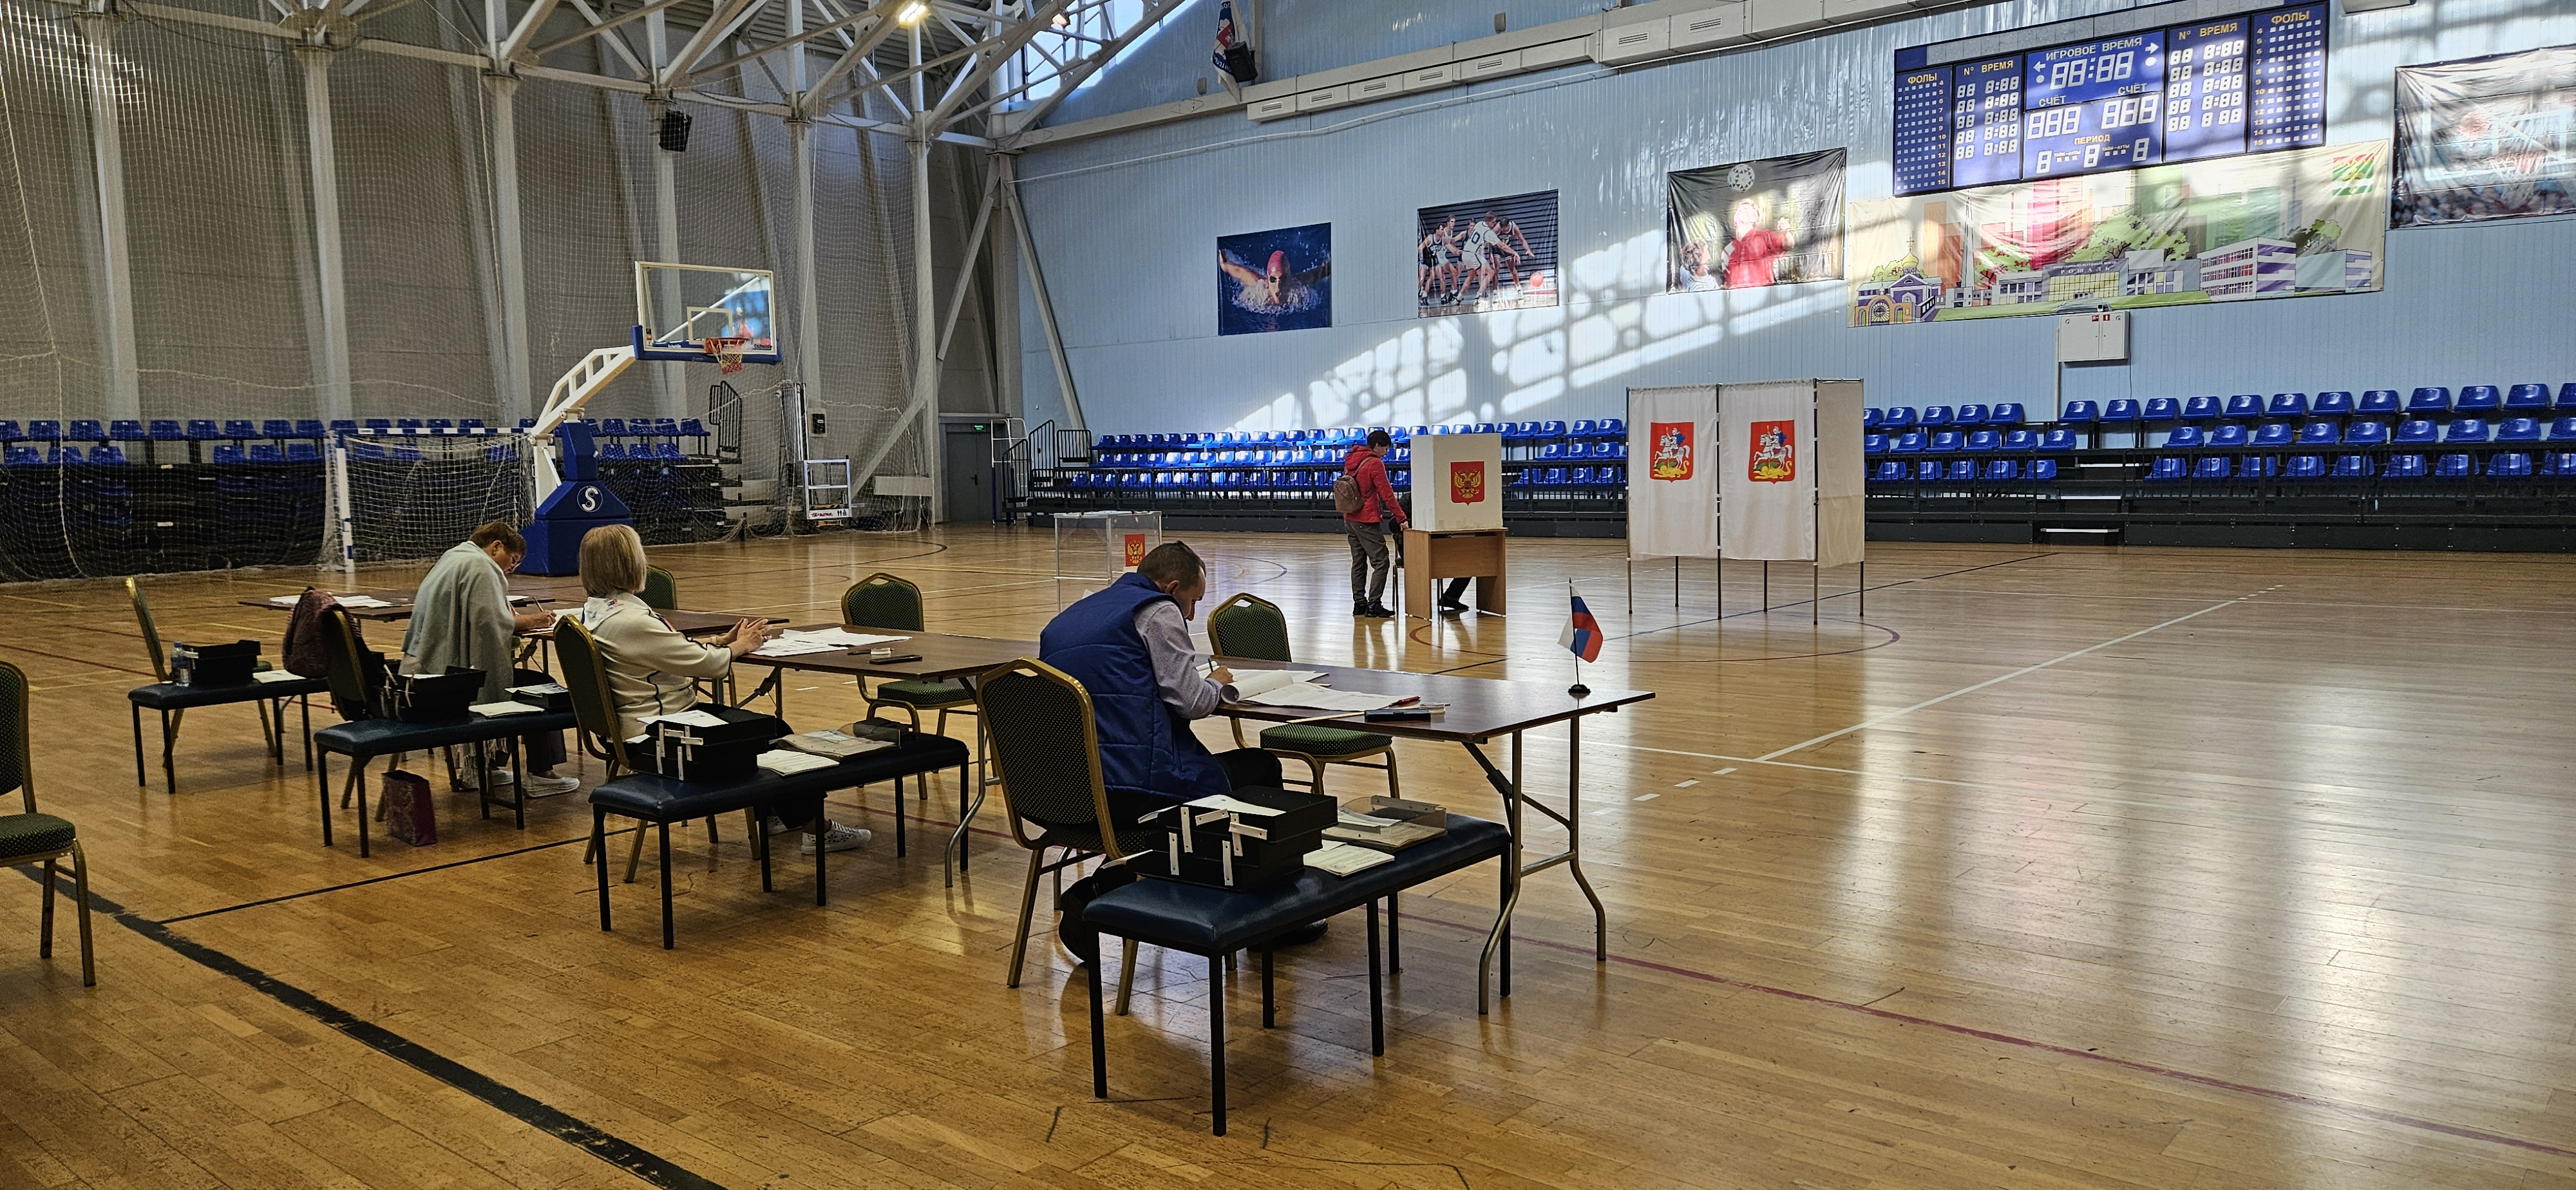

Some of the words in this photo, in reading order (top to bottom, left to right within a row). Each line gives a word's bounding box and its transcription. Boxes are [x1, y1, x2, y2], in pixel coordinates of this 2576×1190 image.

[2271, 10, 2310, 24] ФОЛЫ
[2200, 23, 2237, 37] ВРЕМЯ
[2046, 45, 2096, 61] ИГРОВОЕ
[2102, 37, 2142, 52] ВРЕМЯ
[1982, 60, 2013, 73] ВРЕМЯ
[1908, 73, 1937, 84] ФОЛЫ
[2118, 83, 2147, 95] СЧЁТ
[2039, 95, 2066, 107] СЧЁТ
[2074, 135, 2110, 145] ПЕРИОД
